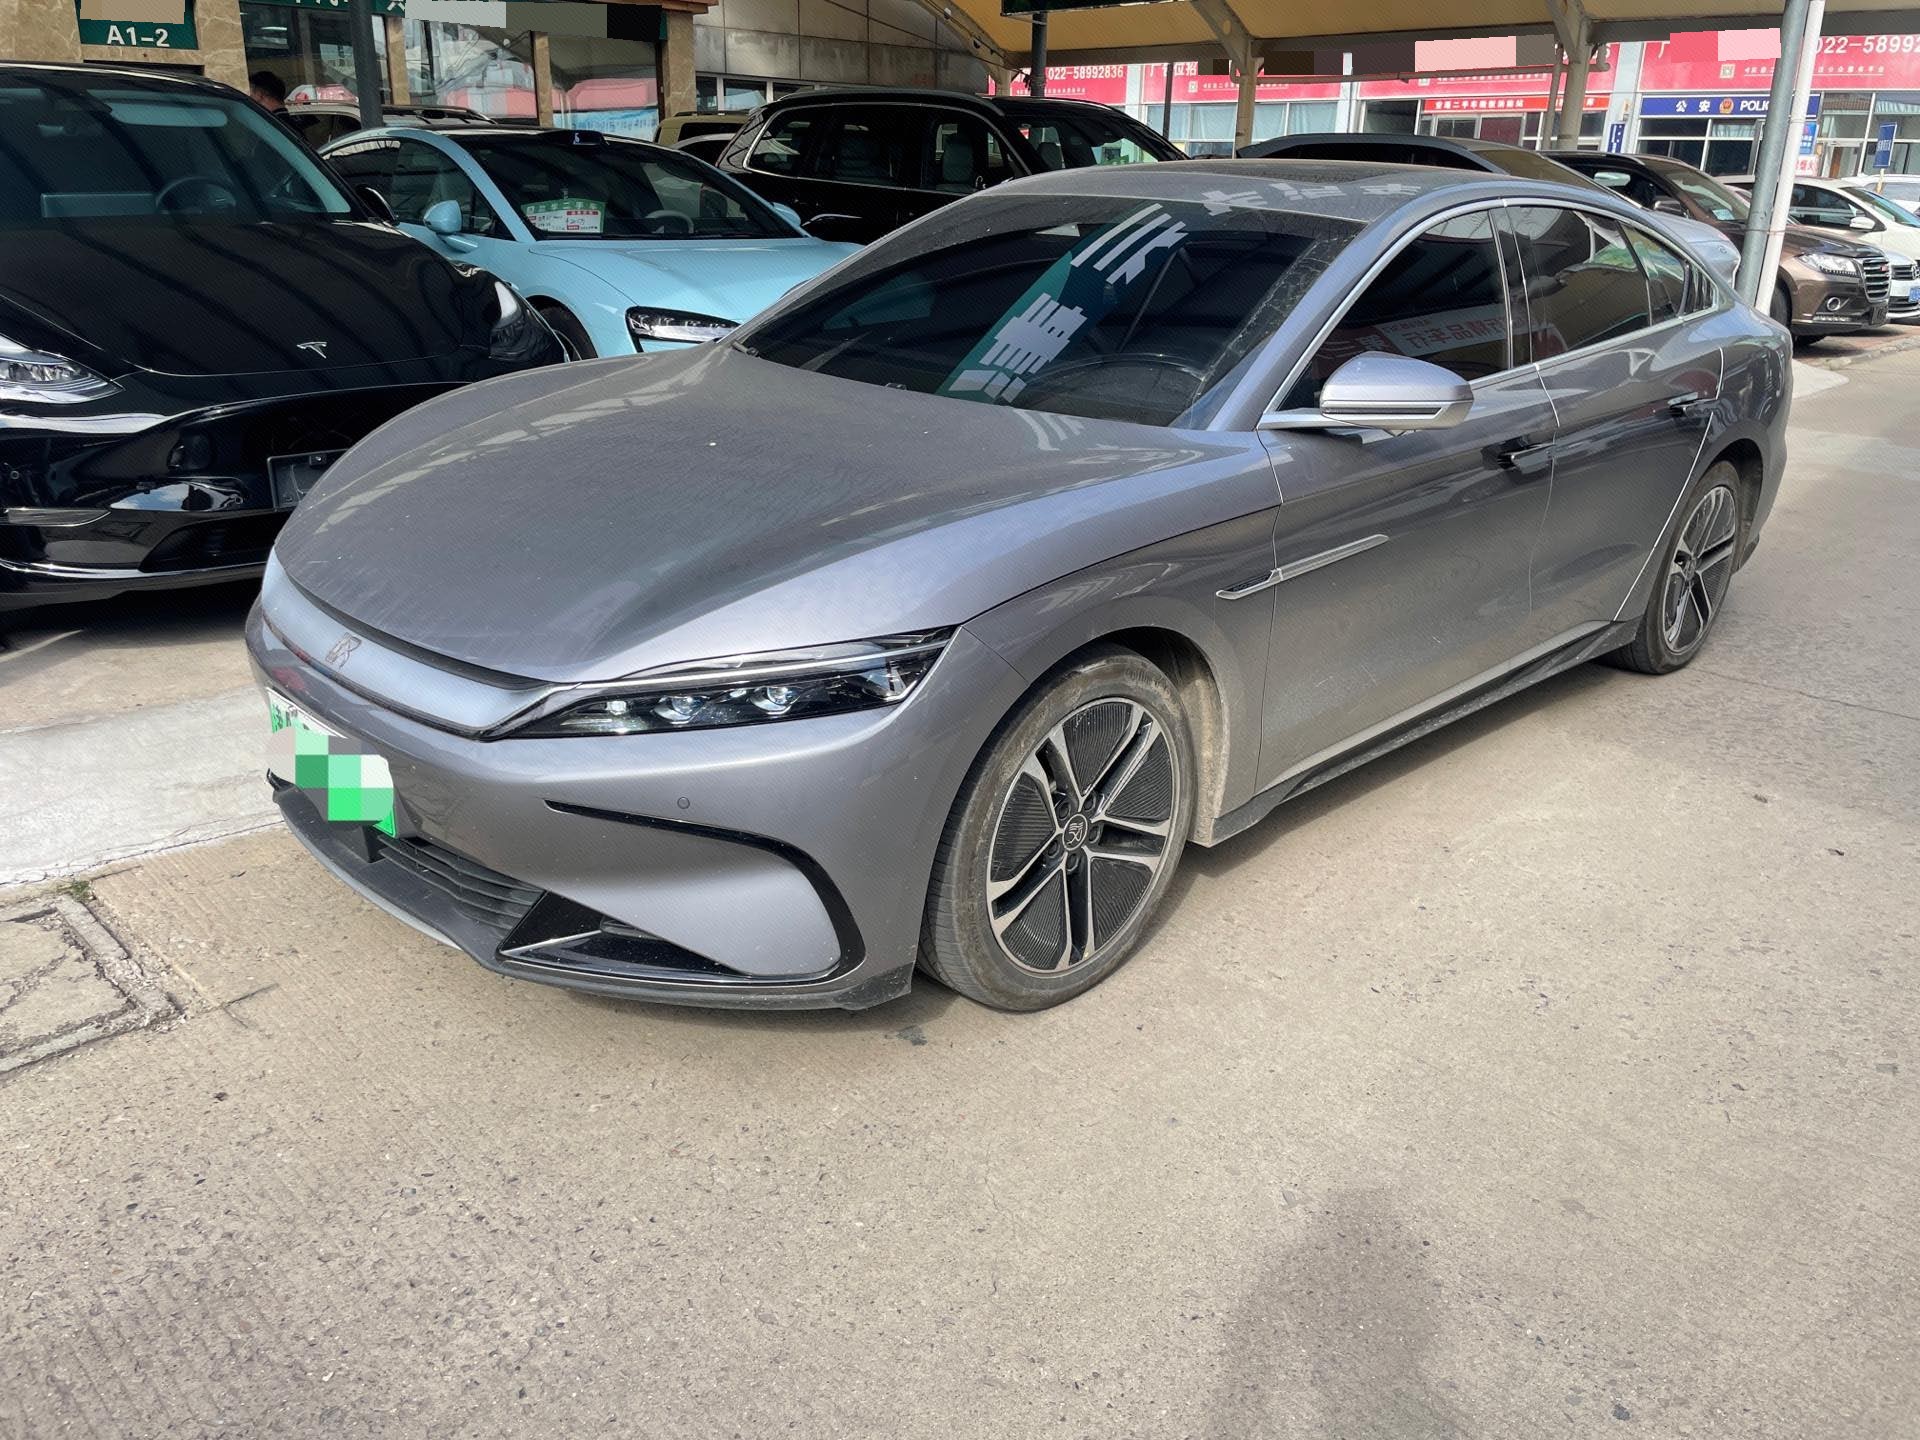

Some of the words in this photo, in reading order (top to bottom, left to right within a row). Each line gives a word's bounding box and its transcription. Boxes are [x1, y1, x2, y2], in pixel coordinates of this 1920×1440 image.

[106, 25, 170, 48] A1-2
[1048, 64, 1124, 81] 022-58992836
[1675, 100, 1711, 113] 公安
